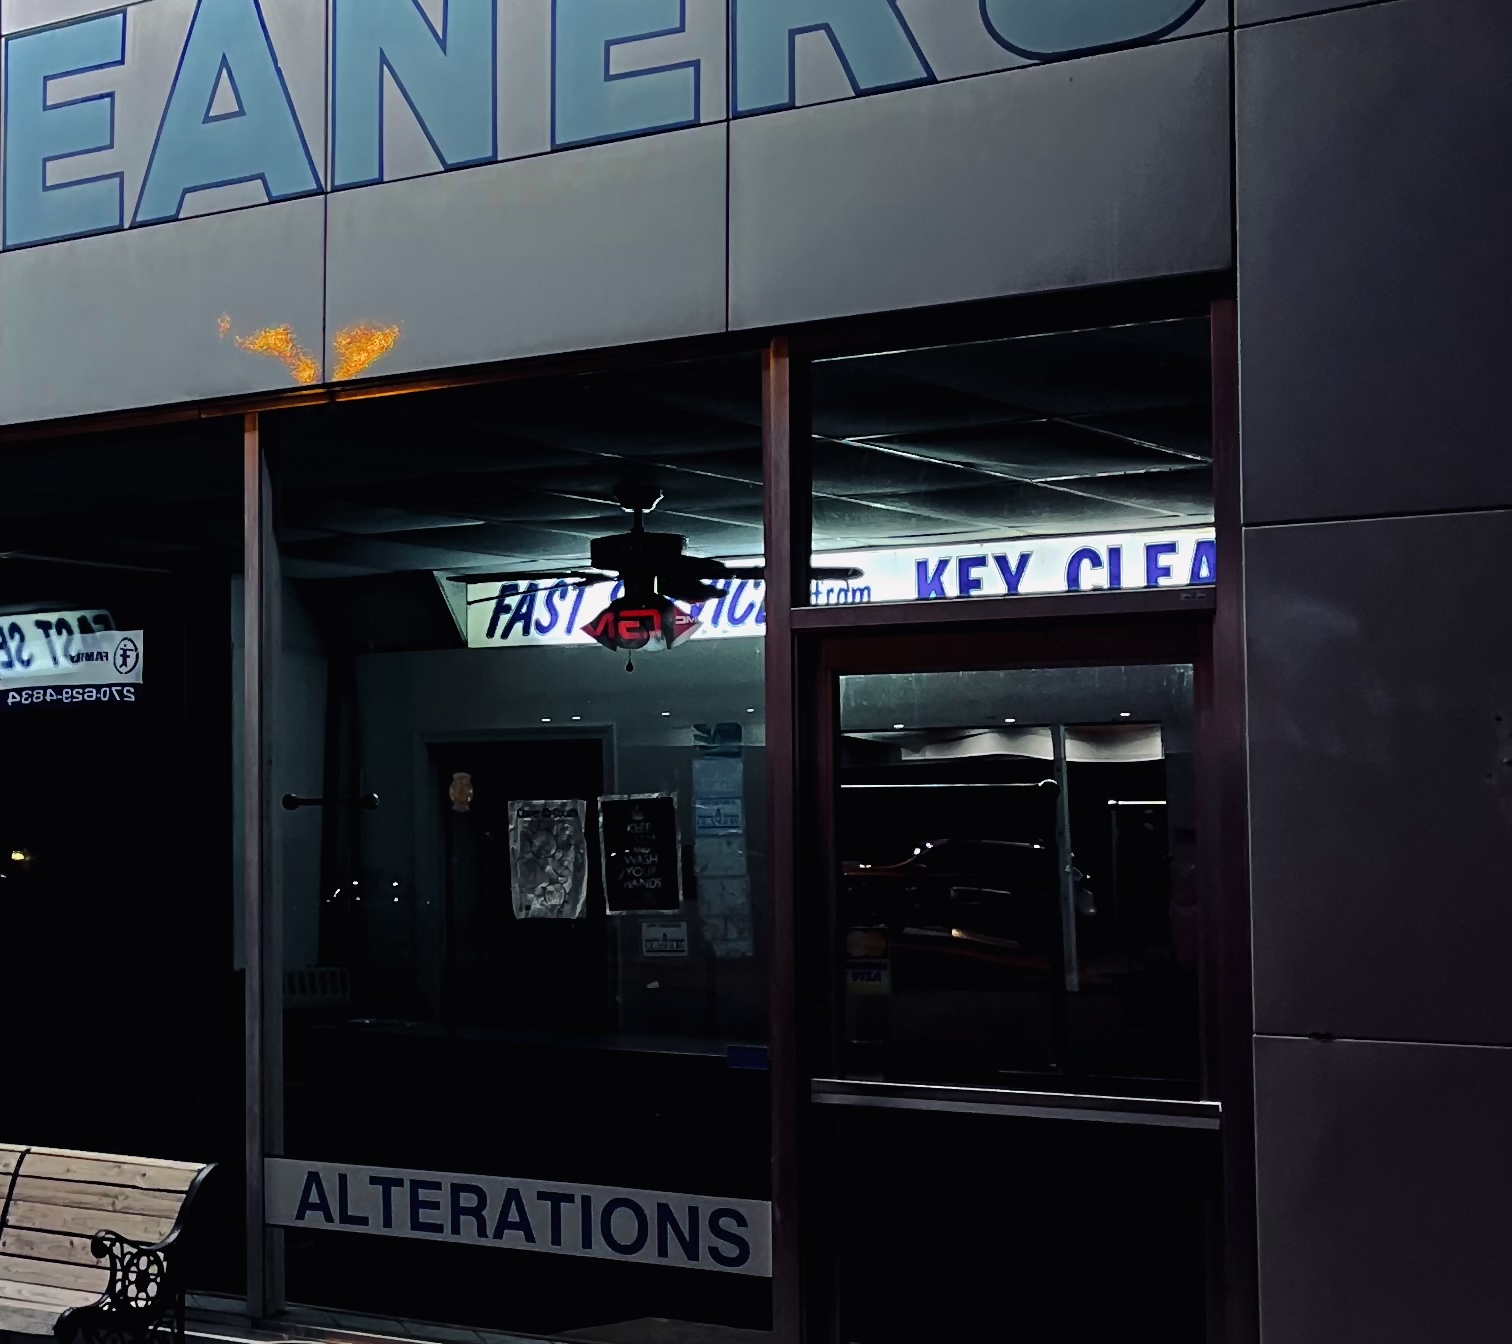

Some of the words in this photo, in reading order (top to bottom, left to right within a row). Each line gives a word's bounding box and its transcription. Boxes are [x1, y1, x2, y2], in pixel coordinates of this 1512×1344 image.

[915, 550, 1033, 600] KEY
[485, 578, 587, 640] FAST
[624, 853, 659, 865] WASH
[624, 877, 662, 889] HANDS
[851, 970, 883, 983] VISA
[295, 1170, 750, 1268] ALTERATIONS
